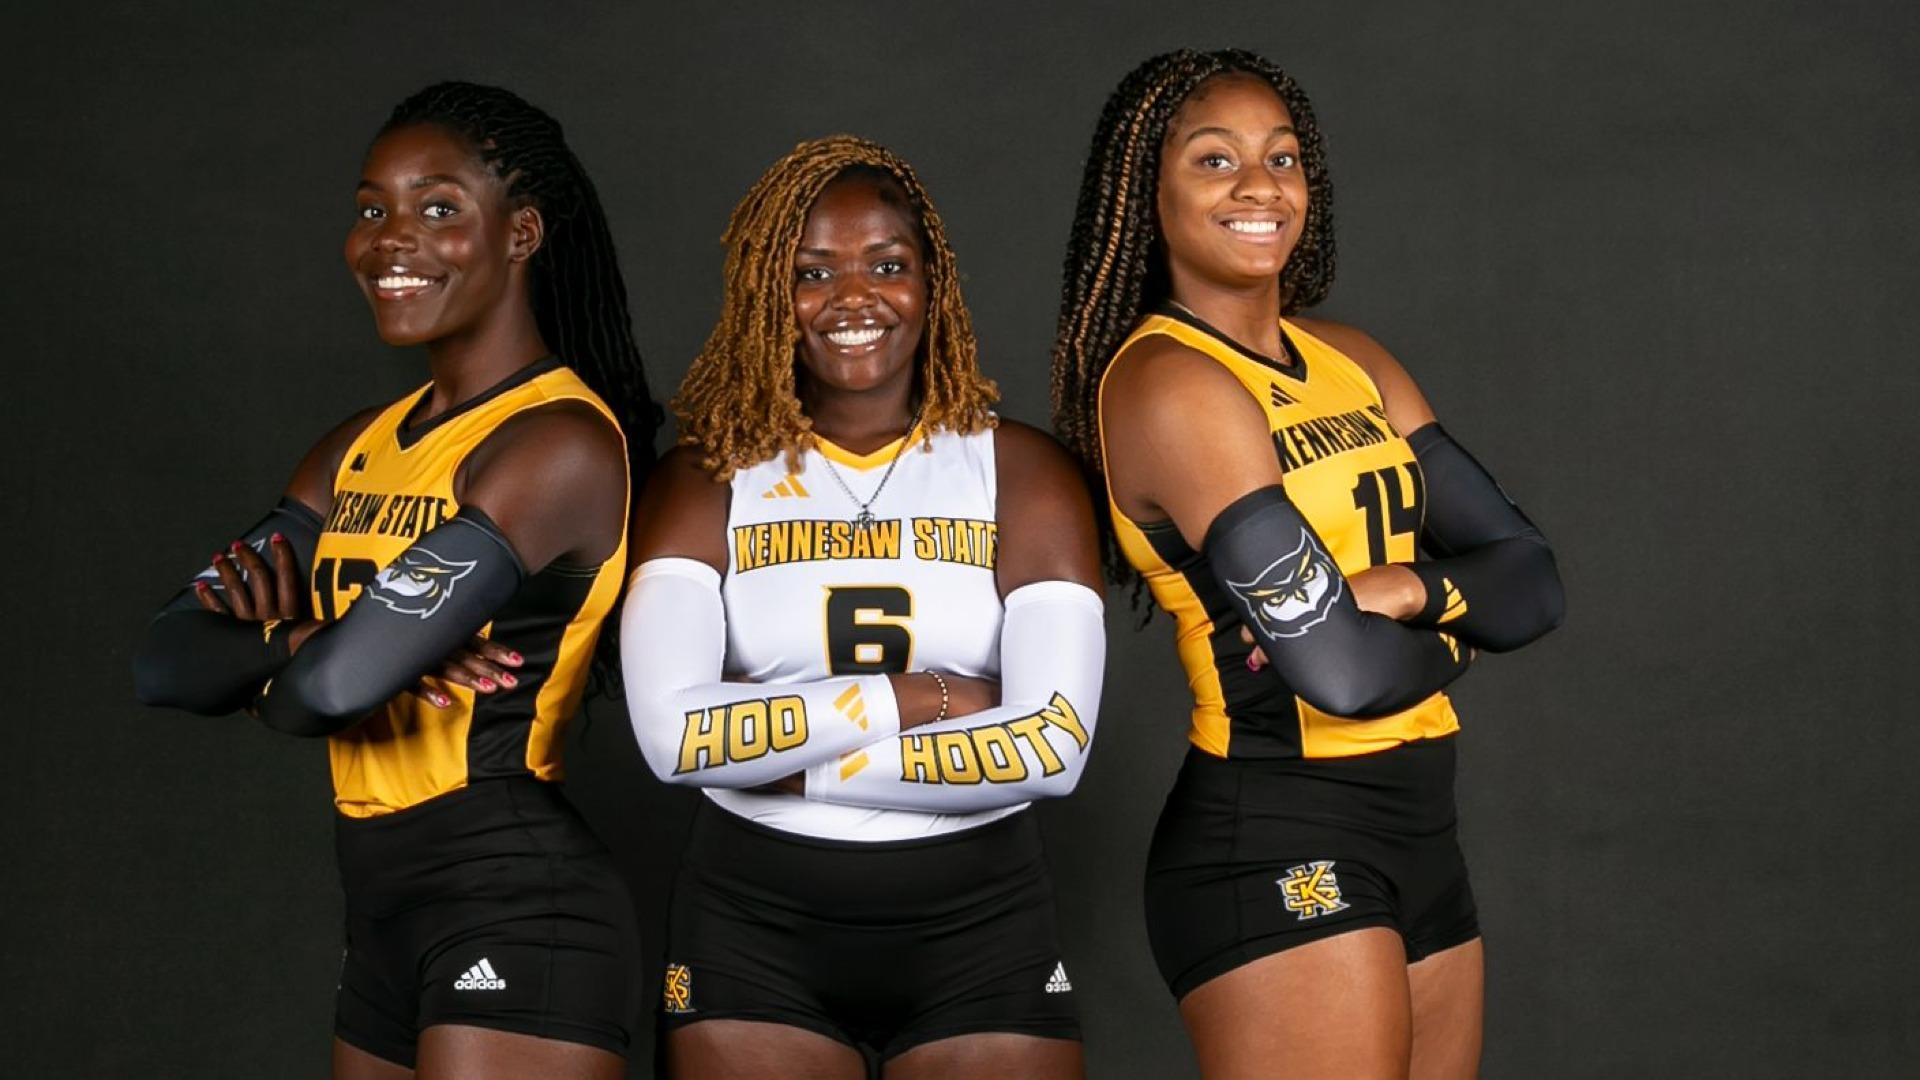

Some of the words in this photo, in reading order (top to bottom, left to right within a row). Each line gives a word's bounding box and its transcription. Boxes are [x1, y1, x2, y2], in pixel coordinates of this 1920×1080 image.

[1272, 409, 1388, 474] KENNESAW
[733, 517, 902, 574] KENNESAW
[911, 516, 998, 570] STATE
[1351, 461, 1424, 566] 14
[822, 583, 915, 677] 6
[671, 693, 809, 777] HOO
[898, 691, 1090, 786] HOOTY
[454, 978, 506, 990] adidas
